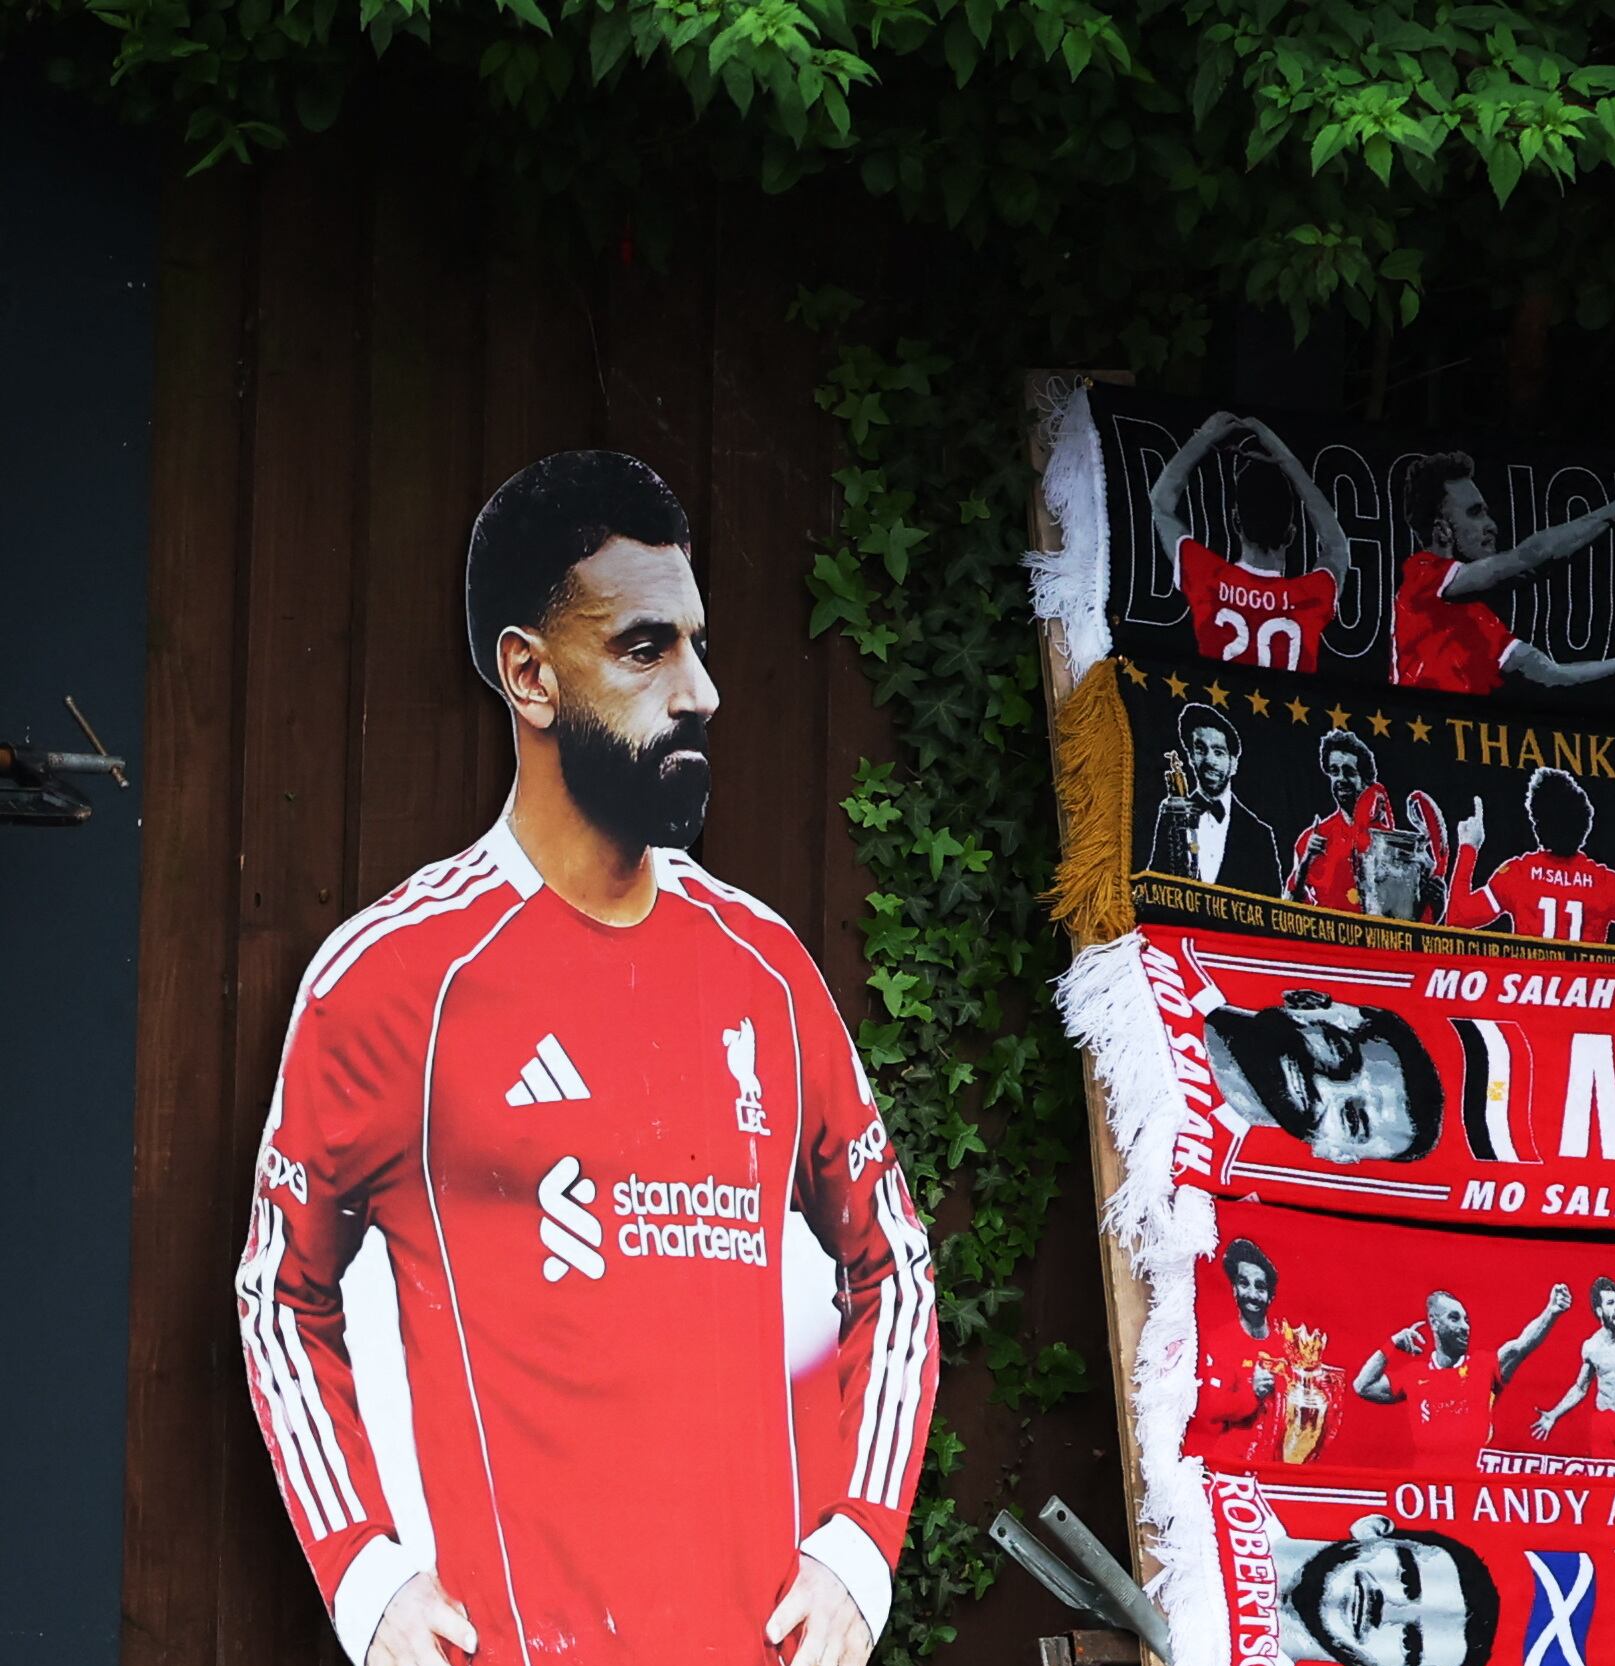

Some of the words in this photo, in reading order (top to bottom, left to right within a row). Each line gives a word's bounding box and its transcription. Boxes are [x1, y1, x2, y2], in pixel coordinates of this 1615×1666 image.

[1218, 581, 1275, 609] DIOGO
[1282, 590, 1296, 611] J.
[1214, 607, 1301, 672] 20
[1531, 867, 1593, 888] M.SALAH
[1133, 882, 1185, 911] PLAYER
[1185, 890, 1202, 912] OF
[1205, 894, 1229, 920] THE
[1230, 899, 1264, 927] YEAR
[1271, 909, 1336, 942] EUROPEAN
[1338, 923, 1363, 947] CUP
[1365, 927, 1413, 952] WINNER
[1422, 934, 1465, 955] WORLD
[1537, 896, 1584, 942] 11
[1142, 945, 1194, 1019] MO
[1425, 968, 1488, 1001] MO
[1165, 1023, 1213, 1176] SALAH
[613, 1173, 761, 1223] standard
[1461, 1180, 1526, 1213] MO
[618, 1216, 768, 1267] chartered
[1395, 1482, 1455, 1520] OH
[1472, 1486, 1590, 1525] ANDY
